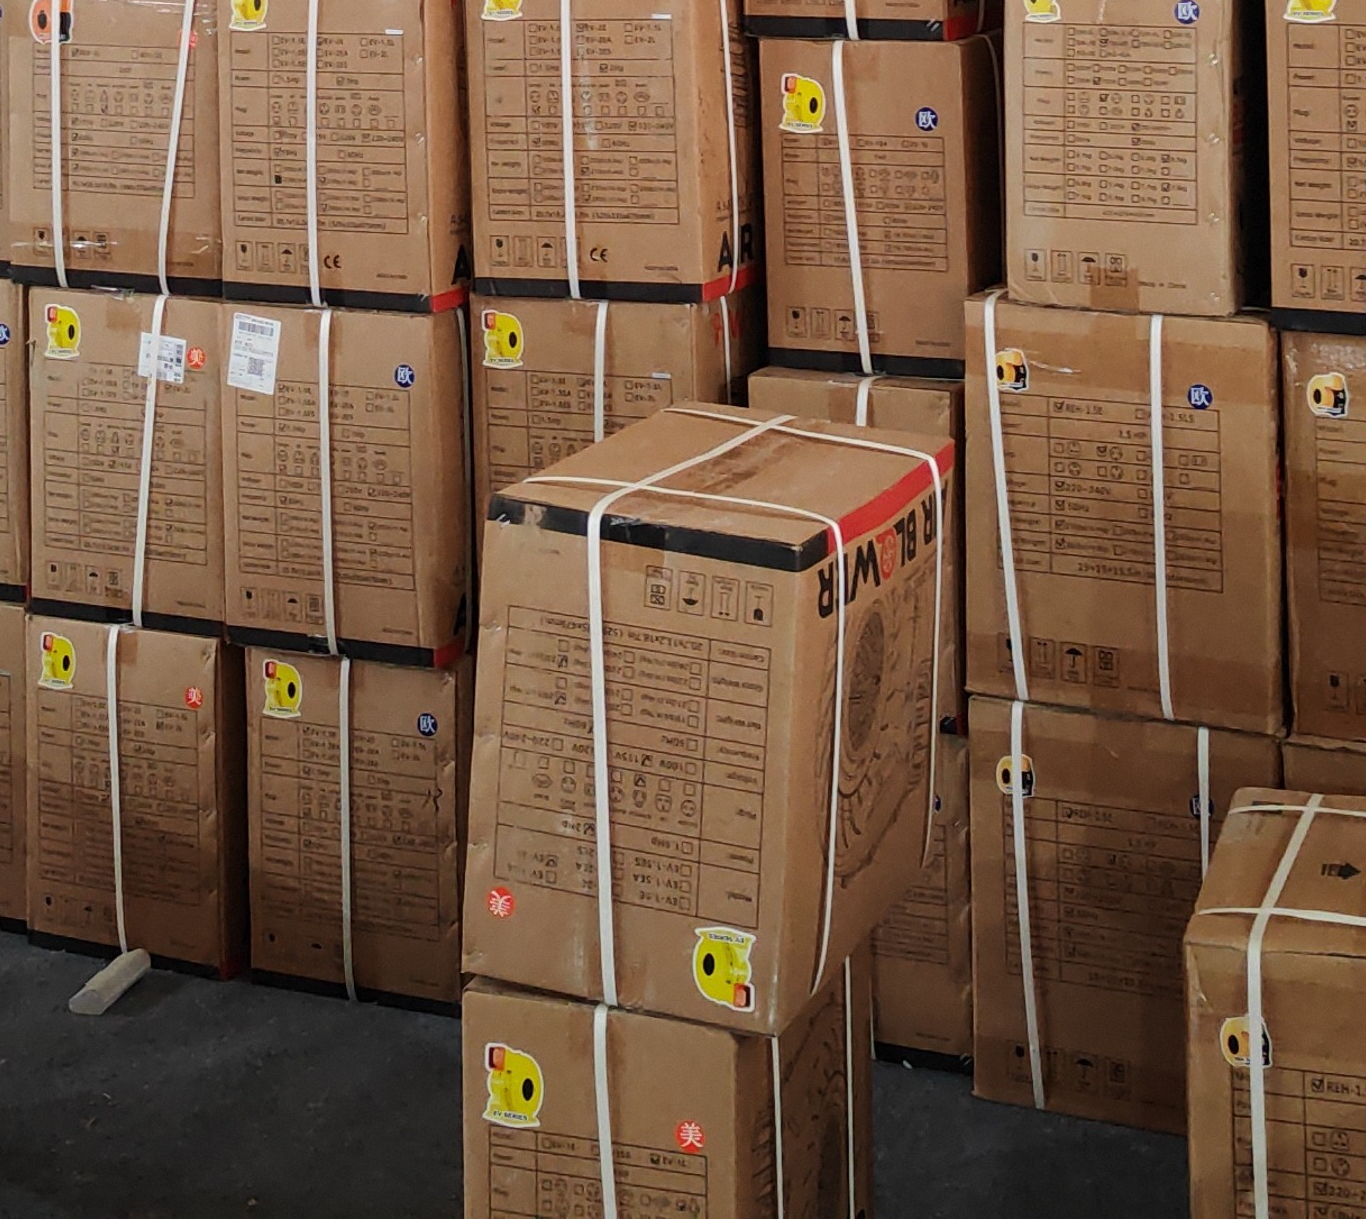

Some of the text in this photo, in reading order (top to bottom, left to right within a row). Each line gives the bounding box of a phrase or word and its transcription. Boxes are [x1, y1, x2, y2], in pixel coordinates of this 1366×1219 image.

[1178, 1, 1199, 22] 欧
[919, 110, 936, 129] 欧
[398, 367, 413, 384] 欧
[1190, 386, 1211, 407] 欧
[421, 716, 437, 734] 欧
[680, 1122, 704, 1148] 美
